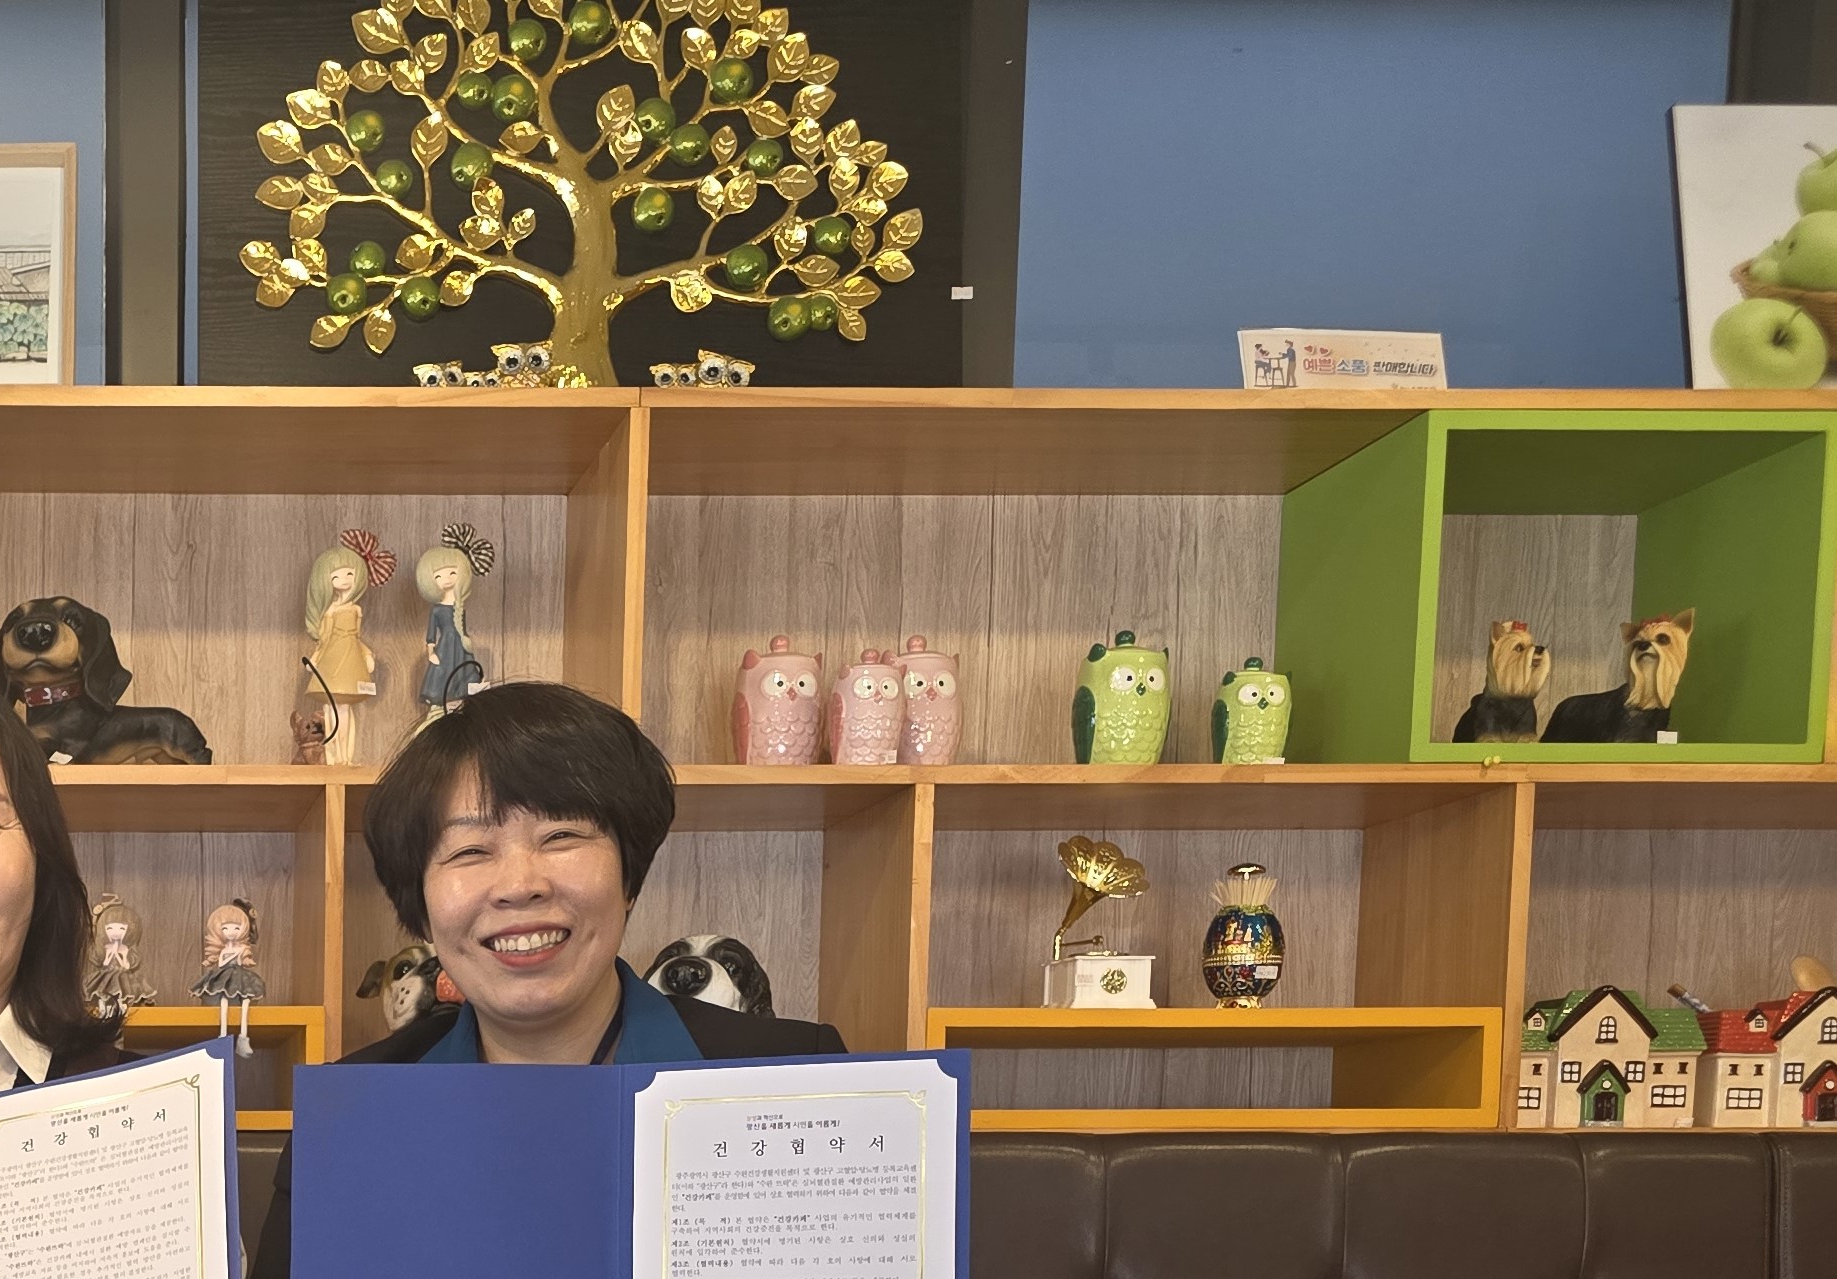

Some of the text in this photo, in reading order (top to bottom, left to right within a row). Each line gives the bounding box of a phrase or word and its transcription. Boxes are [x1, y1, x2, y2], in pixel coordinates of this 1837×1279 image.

[1303, 358, 1434, 374] 예쁜 소품 판매합니다
